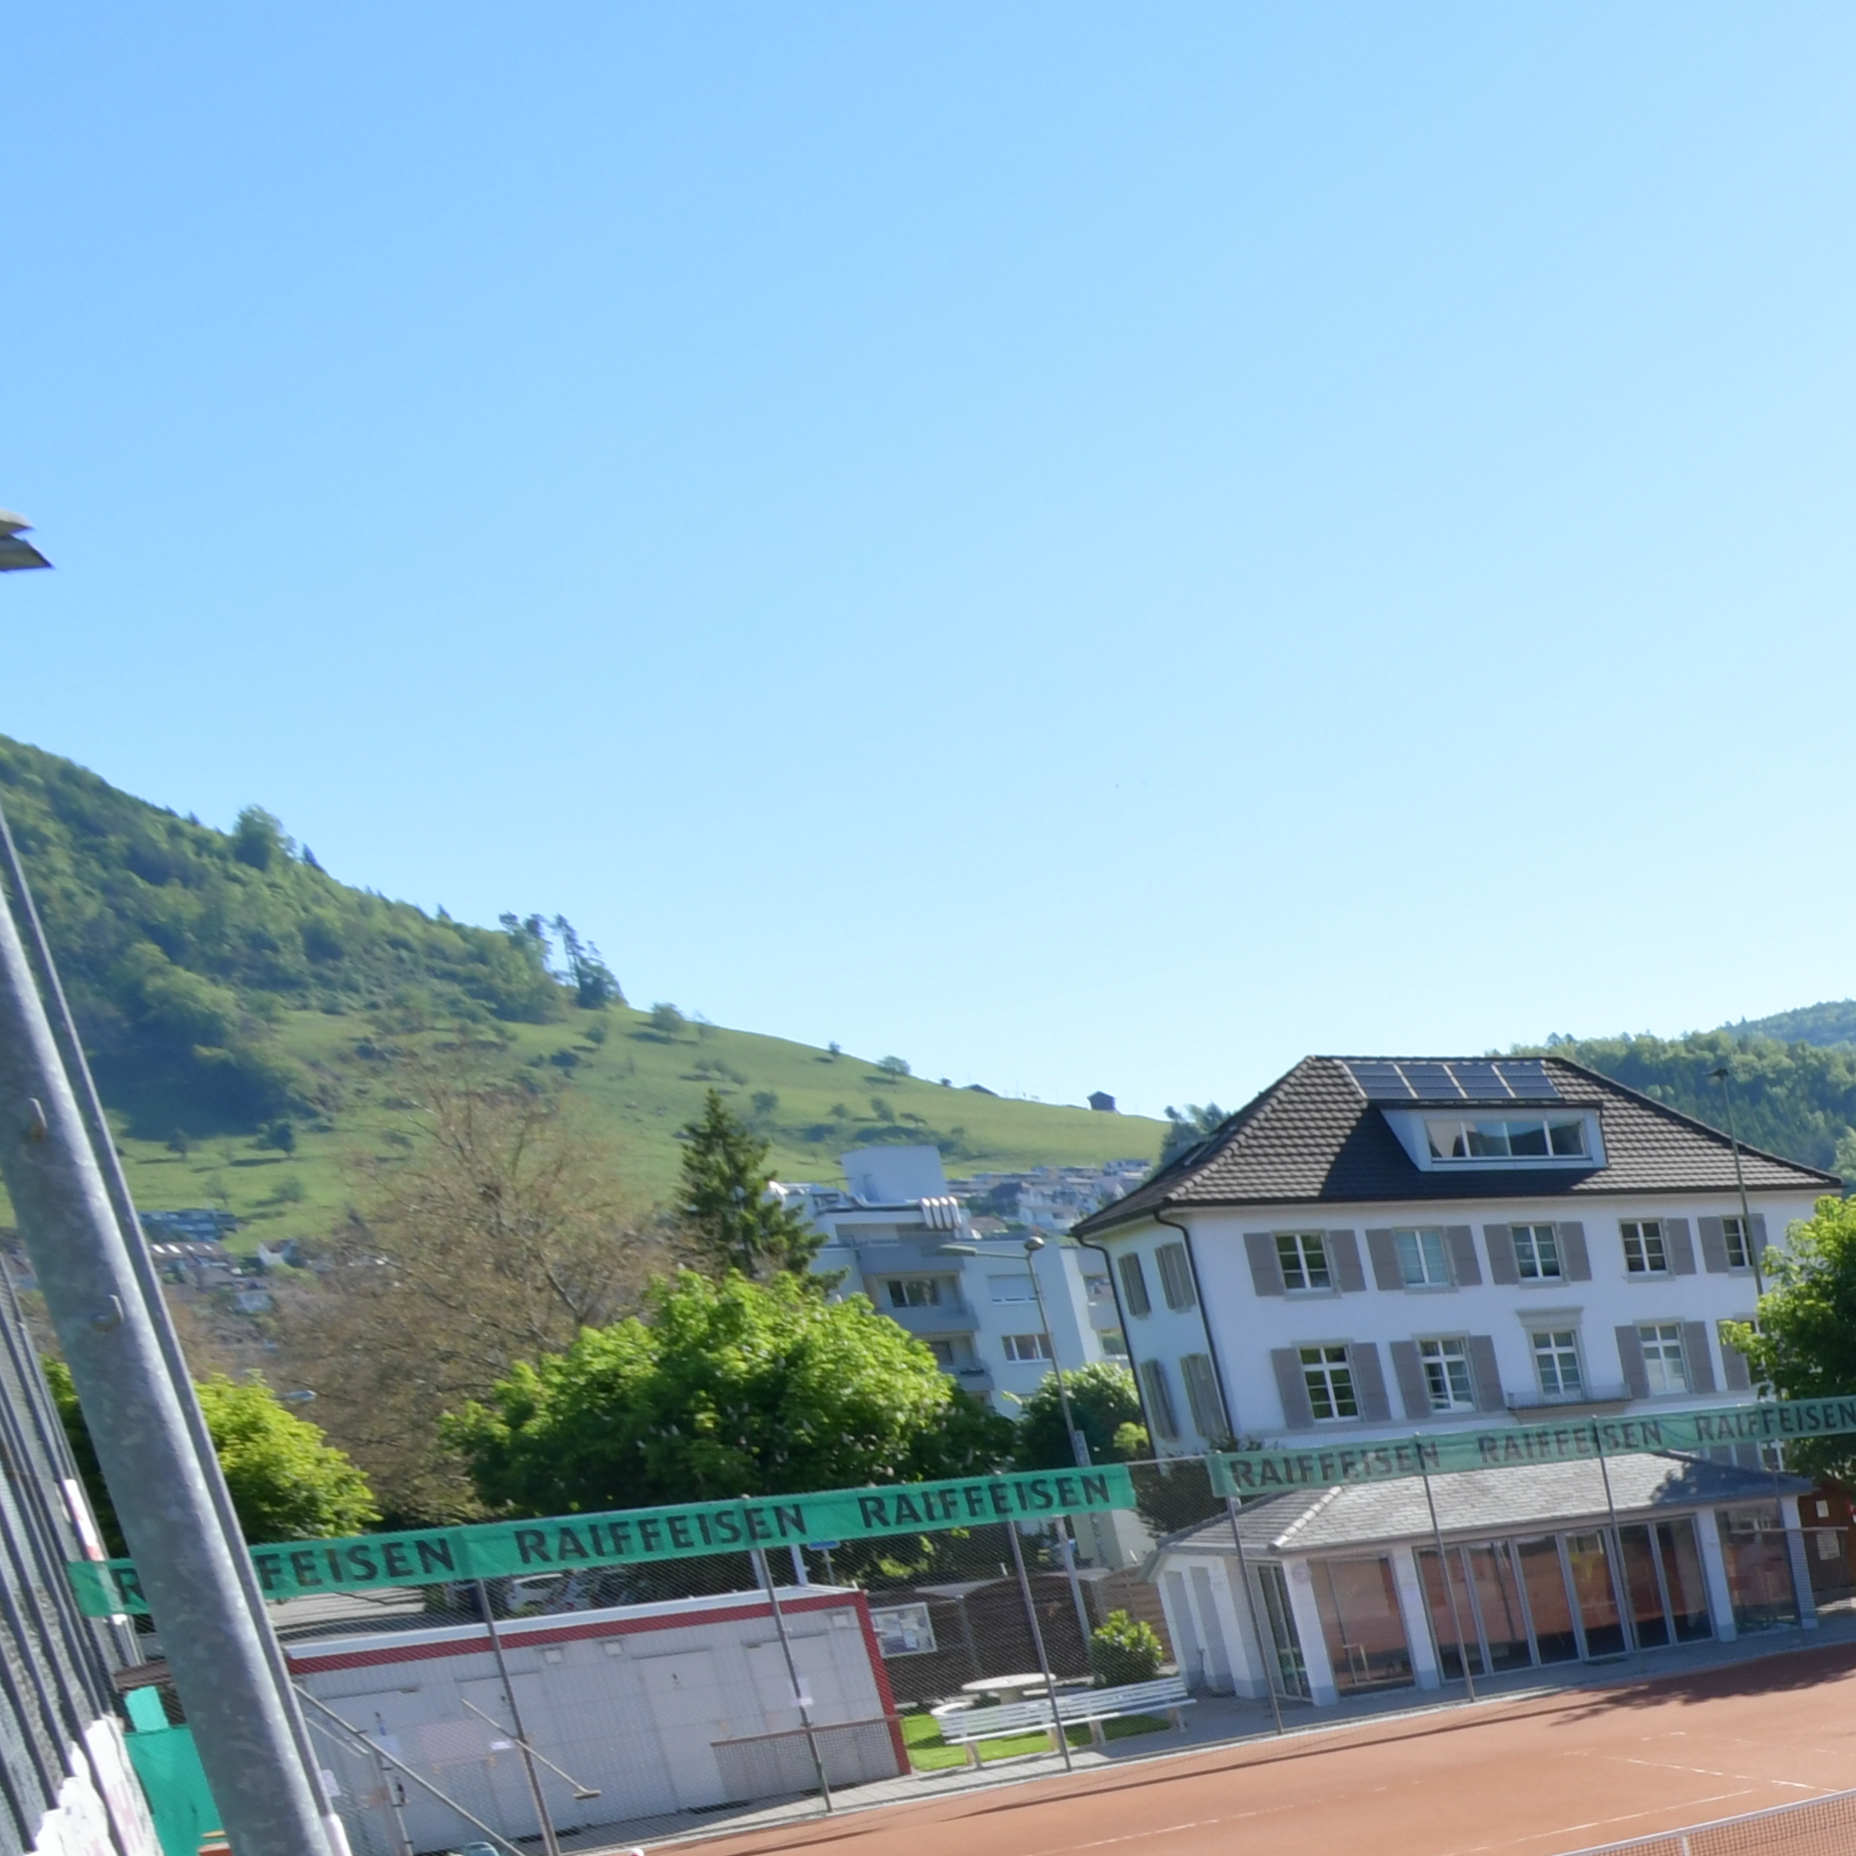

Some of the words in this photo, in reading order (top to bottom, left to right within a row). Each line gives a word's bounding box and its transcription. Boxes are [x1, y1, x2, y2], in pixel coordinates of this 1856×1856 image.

[1229, 1442, 1441, 1489] RAIFFEISEN
[1478, 1420, 1663, 1464] RAIFFEISEN
[857, 1474, 1111, 1528] RAIFFEISEN
[514, 1504, 808, 1564] RAIFFEISEN
[111, 1538, 456, 1604] RFEISEN
